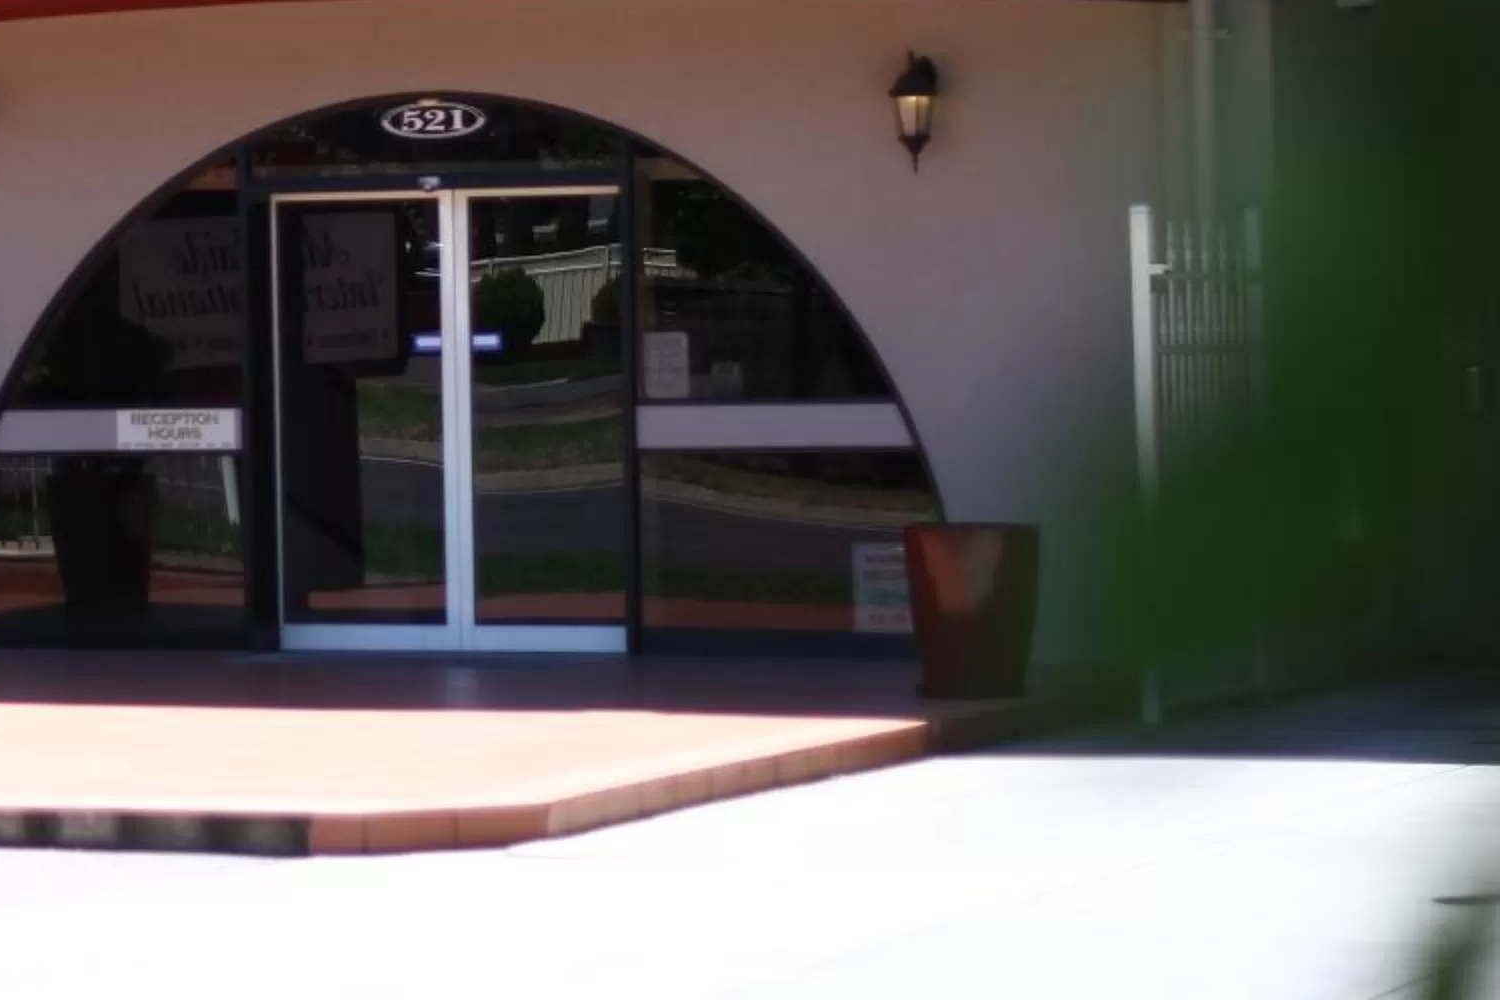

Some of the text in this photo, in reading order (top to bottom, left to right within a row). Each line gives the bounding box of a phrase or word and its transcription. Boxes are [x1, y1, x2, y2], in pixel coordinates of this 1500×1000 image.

[403, 109, 463, 131] 521
[130, 411, 220, 425] RECEPTION
[148, 427, 202, 440] HOURS
